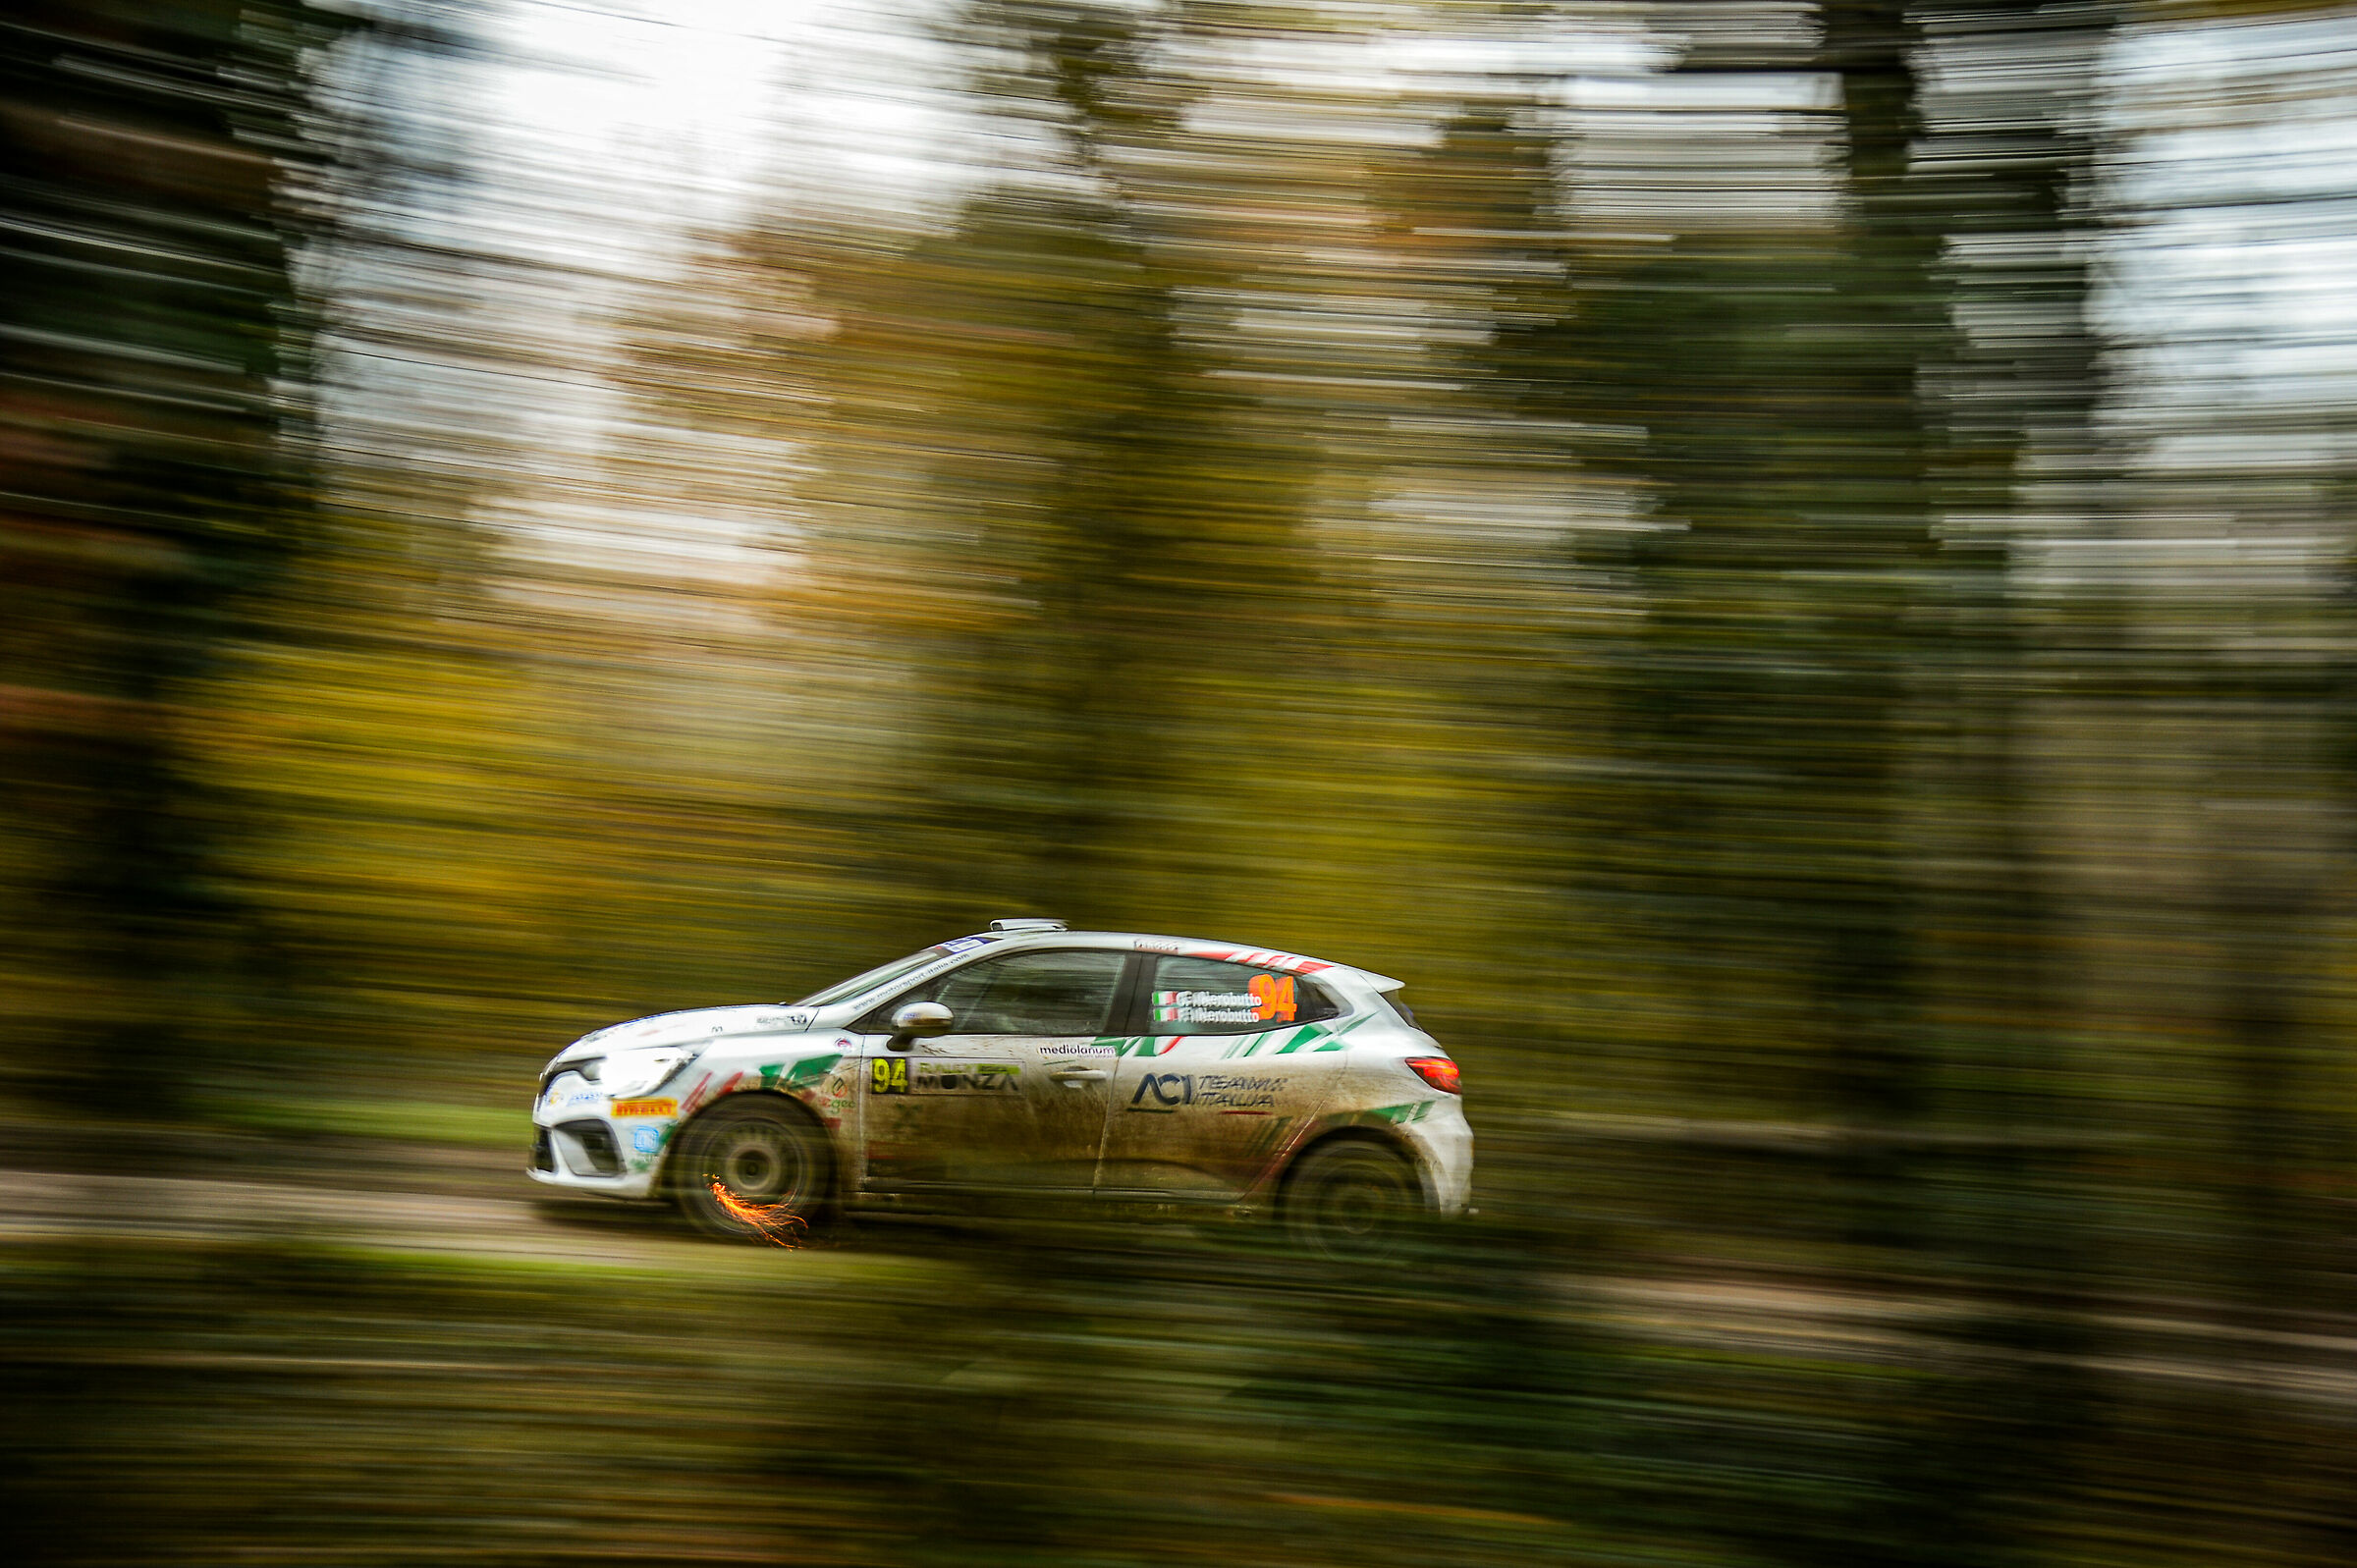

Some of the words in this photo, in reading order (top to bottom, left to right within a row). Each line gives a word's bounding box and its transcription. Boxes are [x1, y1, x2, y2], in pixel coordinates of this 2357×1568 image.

[1249, 973, 1297, 1022] 94
[1040, 1044, 1115, 1054] mediolanum
[872, 1057, 908, 1094] 94
[1130, 1072, 1194, 1106] ACI
